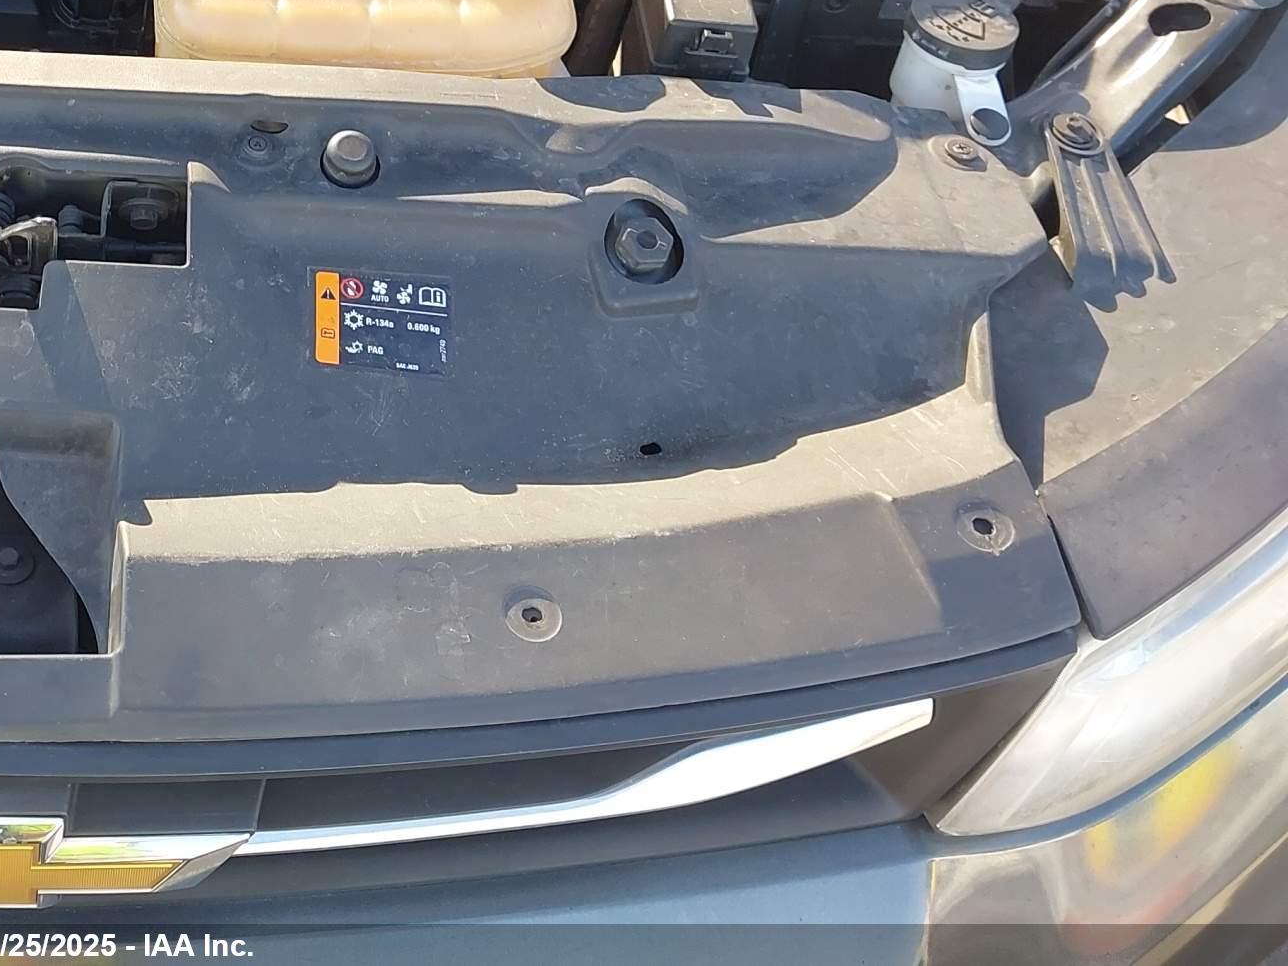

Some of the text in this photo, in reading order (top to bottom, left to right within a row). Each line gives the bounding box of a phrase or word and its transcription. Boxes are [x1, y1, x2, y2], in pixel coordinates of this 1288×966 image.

[370, 294, 390, 303] AUTO
[365, 317, 395, 329] R-134a
[430, 326, 441, 335] kg
[367, 345, 384, 355] PAG
